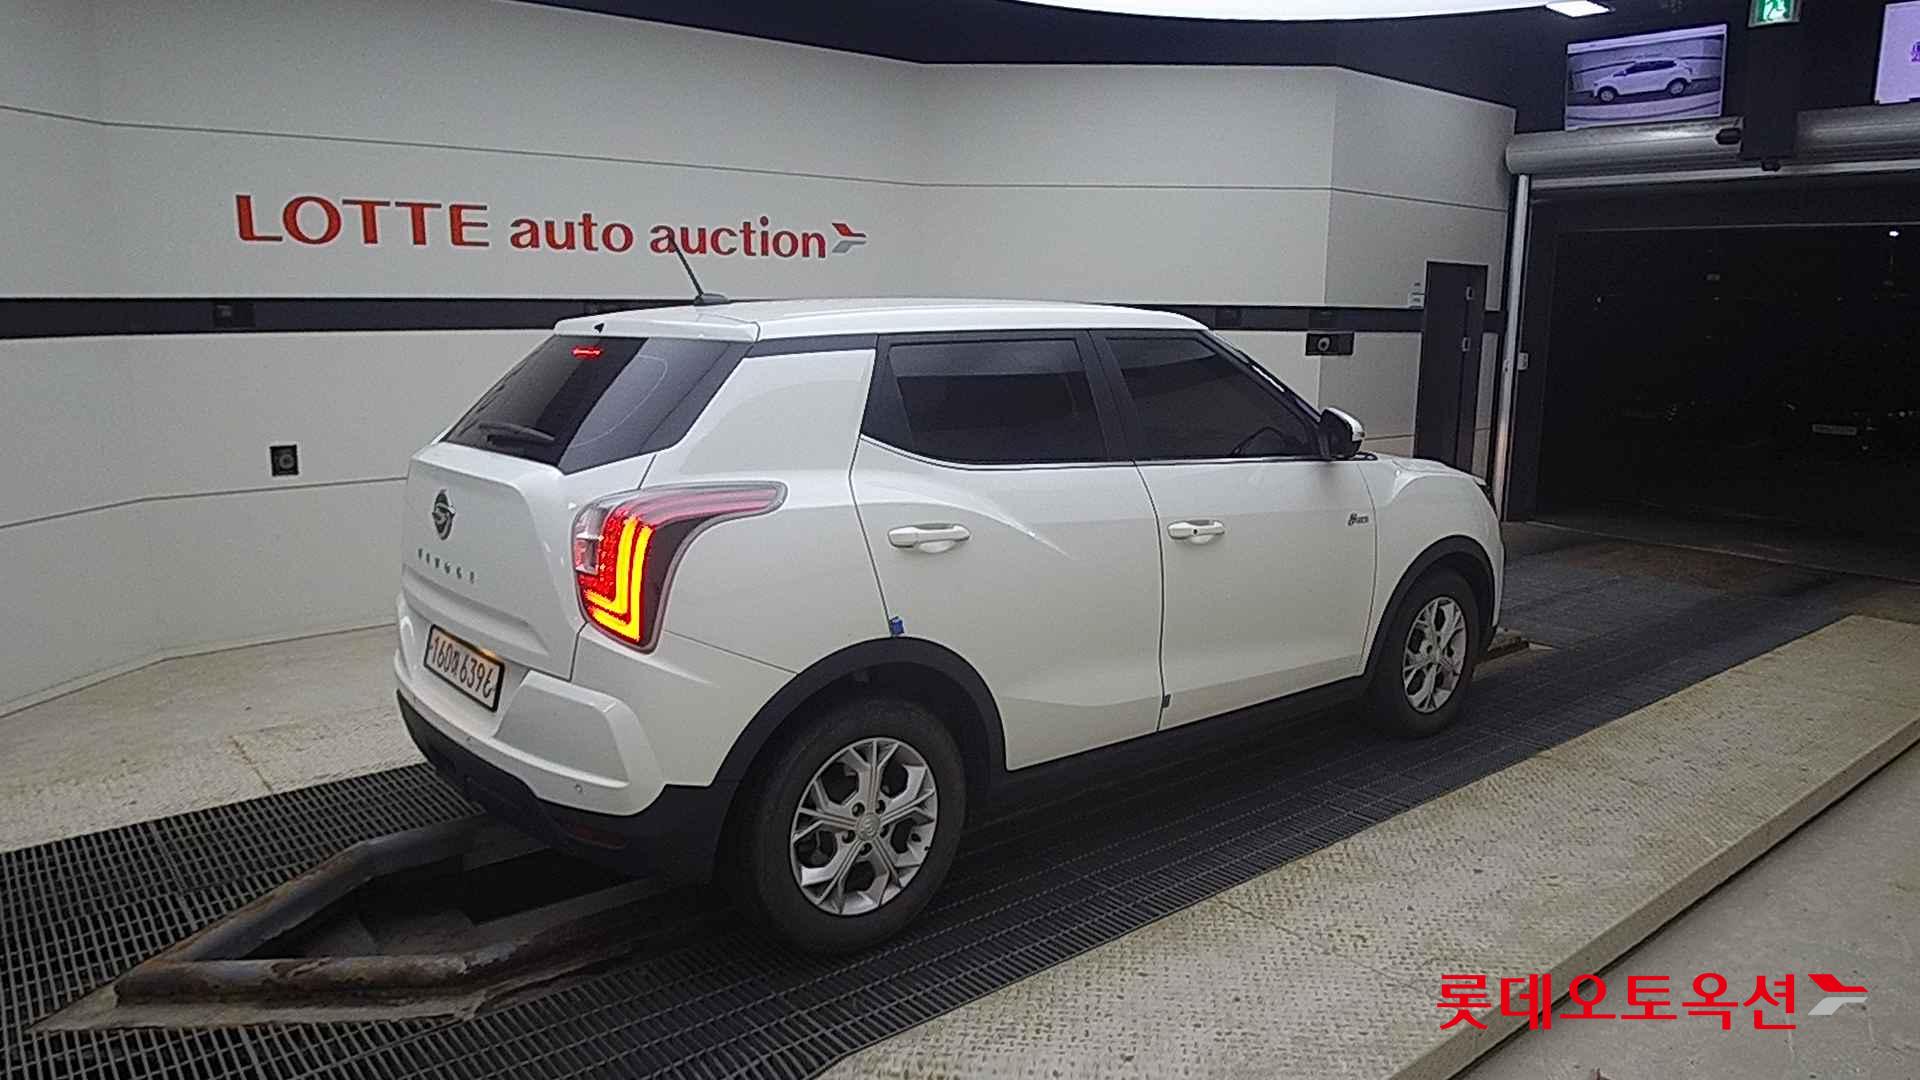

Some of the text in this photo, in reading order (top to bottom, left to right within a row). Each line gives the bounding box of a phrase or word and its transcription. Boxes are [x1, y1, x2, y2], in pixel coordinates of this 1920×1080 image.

[235, 194, 827, 258] LOTTE auto auction
